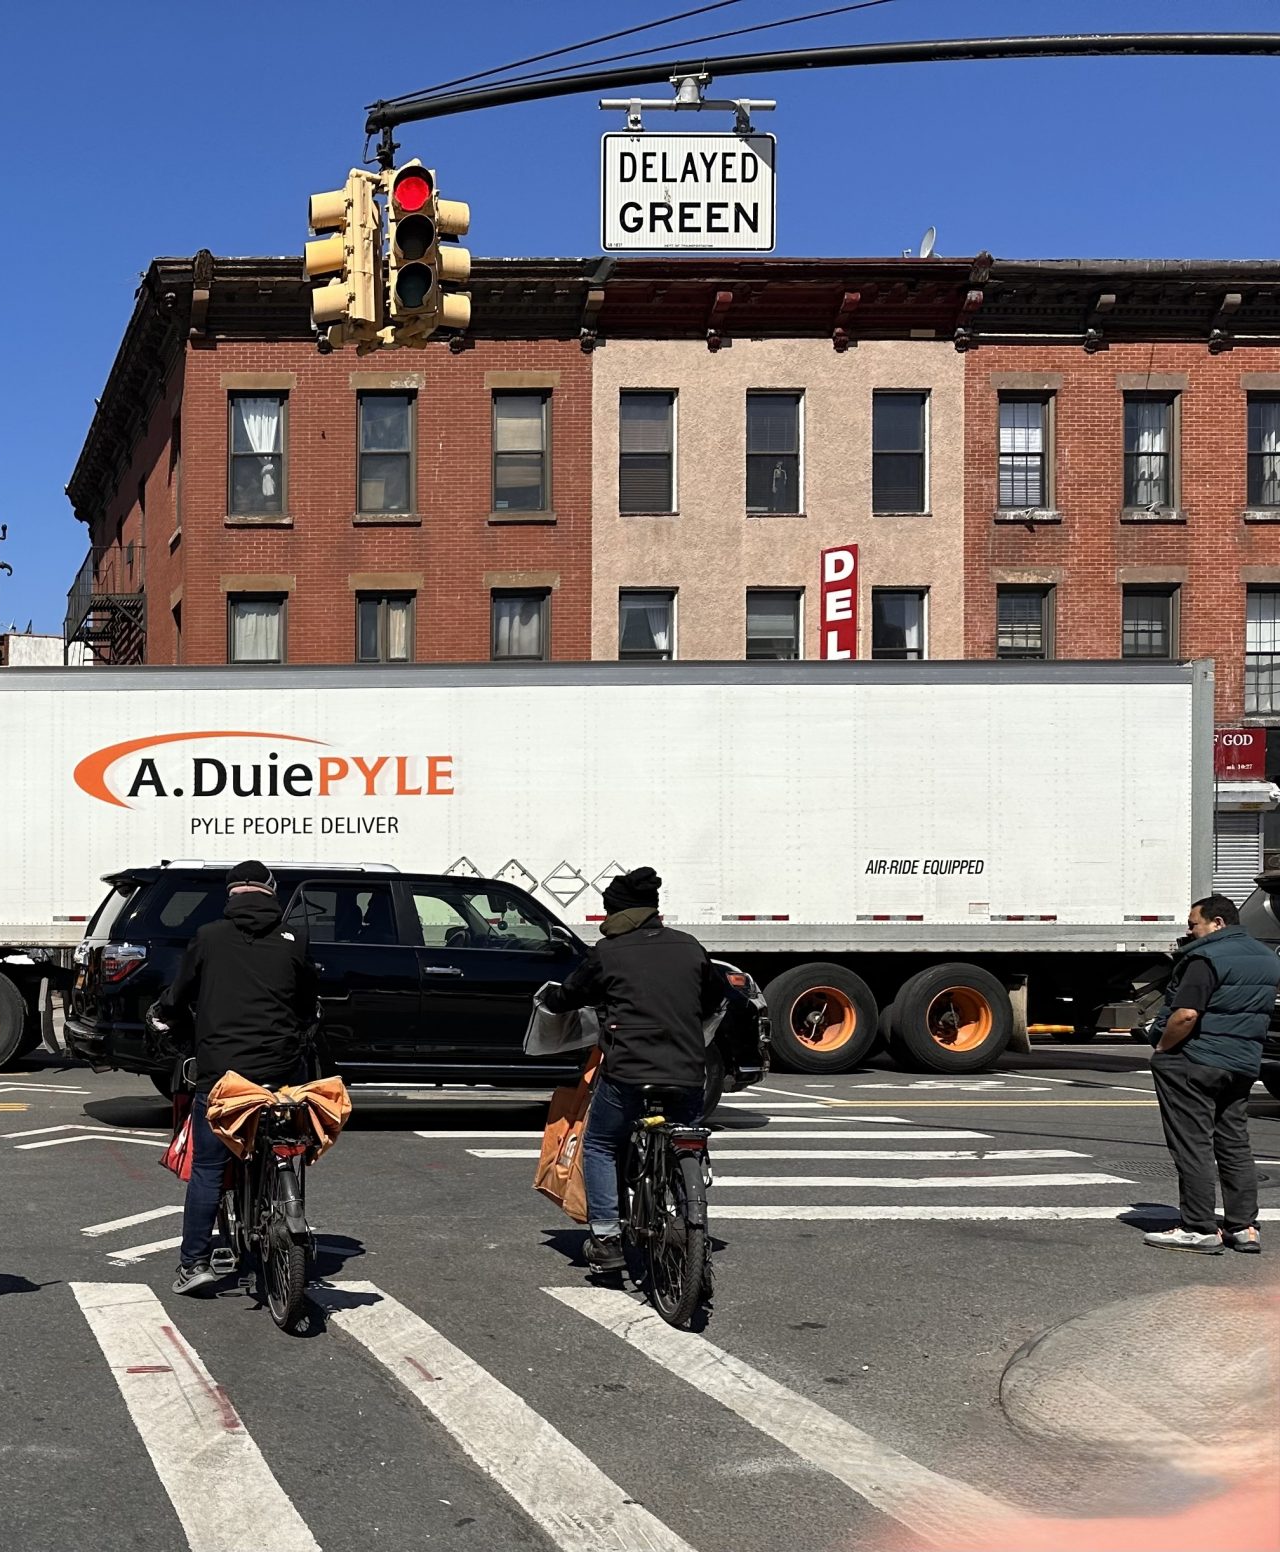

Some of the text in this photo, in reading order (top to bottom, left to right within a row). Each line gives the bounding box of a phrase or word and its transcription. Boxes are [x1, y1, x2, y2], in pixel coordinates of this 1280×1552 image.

[620, 152, 759, 183] DELAYED
[619, 202, 759, 233] GREEN
[1222, 734, 1254, 746] GOD
[191, 816, 400, 835] PYLE PEOPLE DELIVER
[865, 860, 985, 875] AIR-RIDE EQUIPPED
